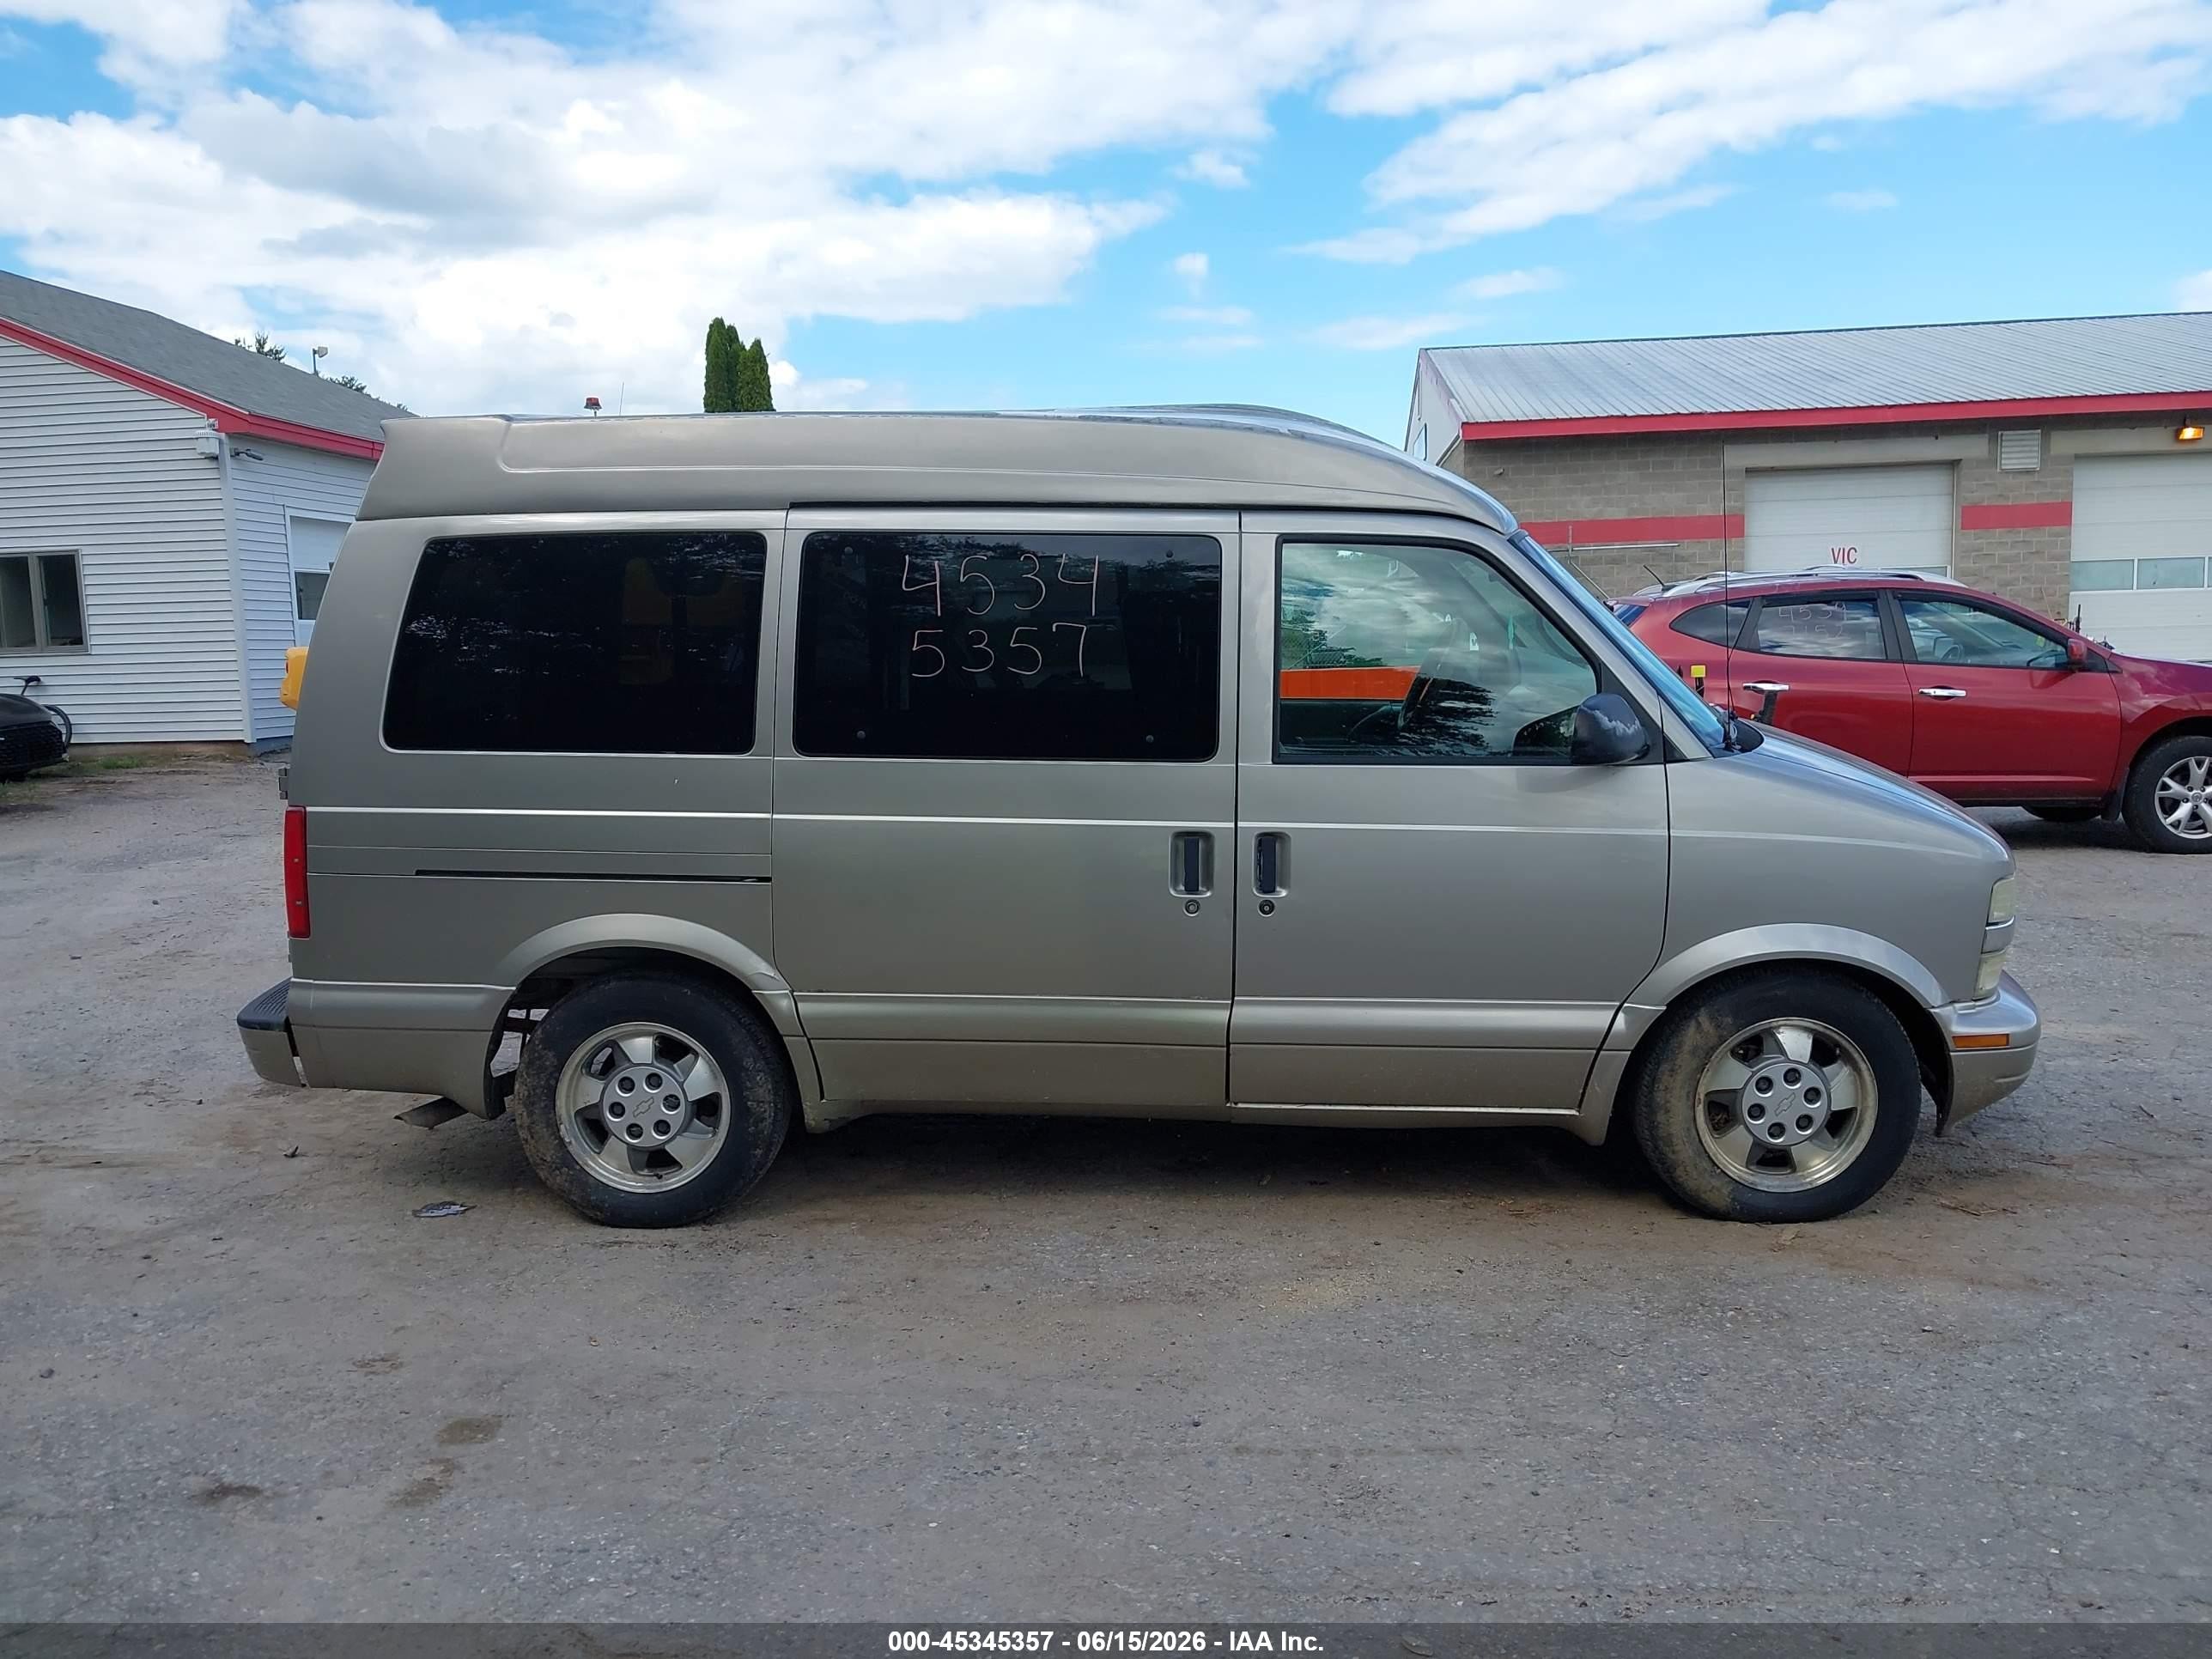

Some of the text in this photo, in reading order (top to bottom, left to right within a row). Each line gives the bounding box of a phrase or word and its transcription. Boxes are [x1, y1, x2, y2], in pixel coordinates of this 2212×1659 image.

[1831, 547, 1857, 564] VIC
[902, 553, 1099, 617] 4534
[911, 623, 1087, 678] 5357
